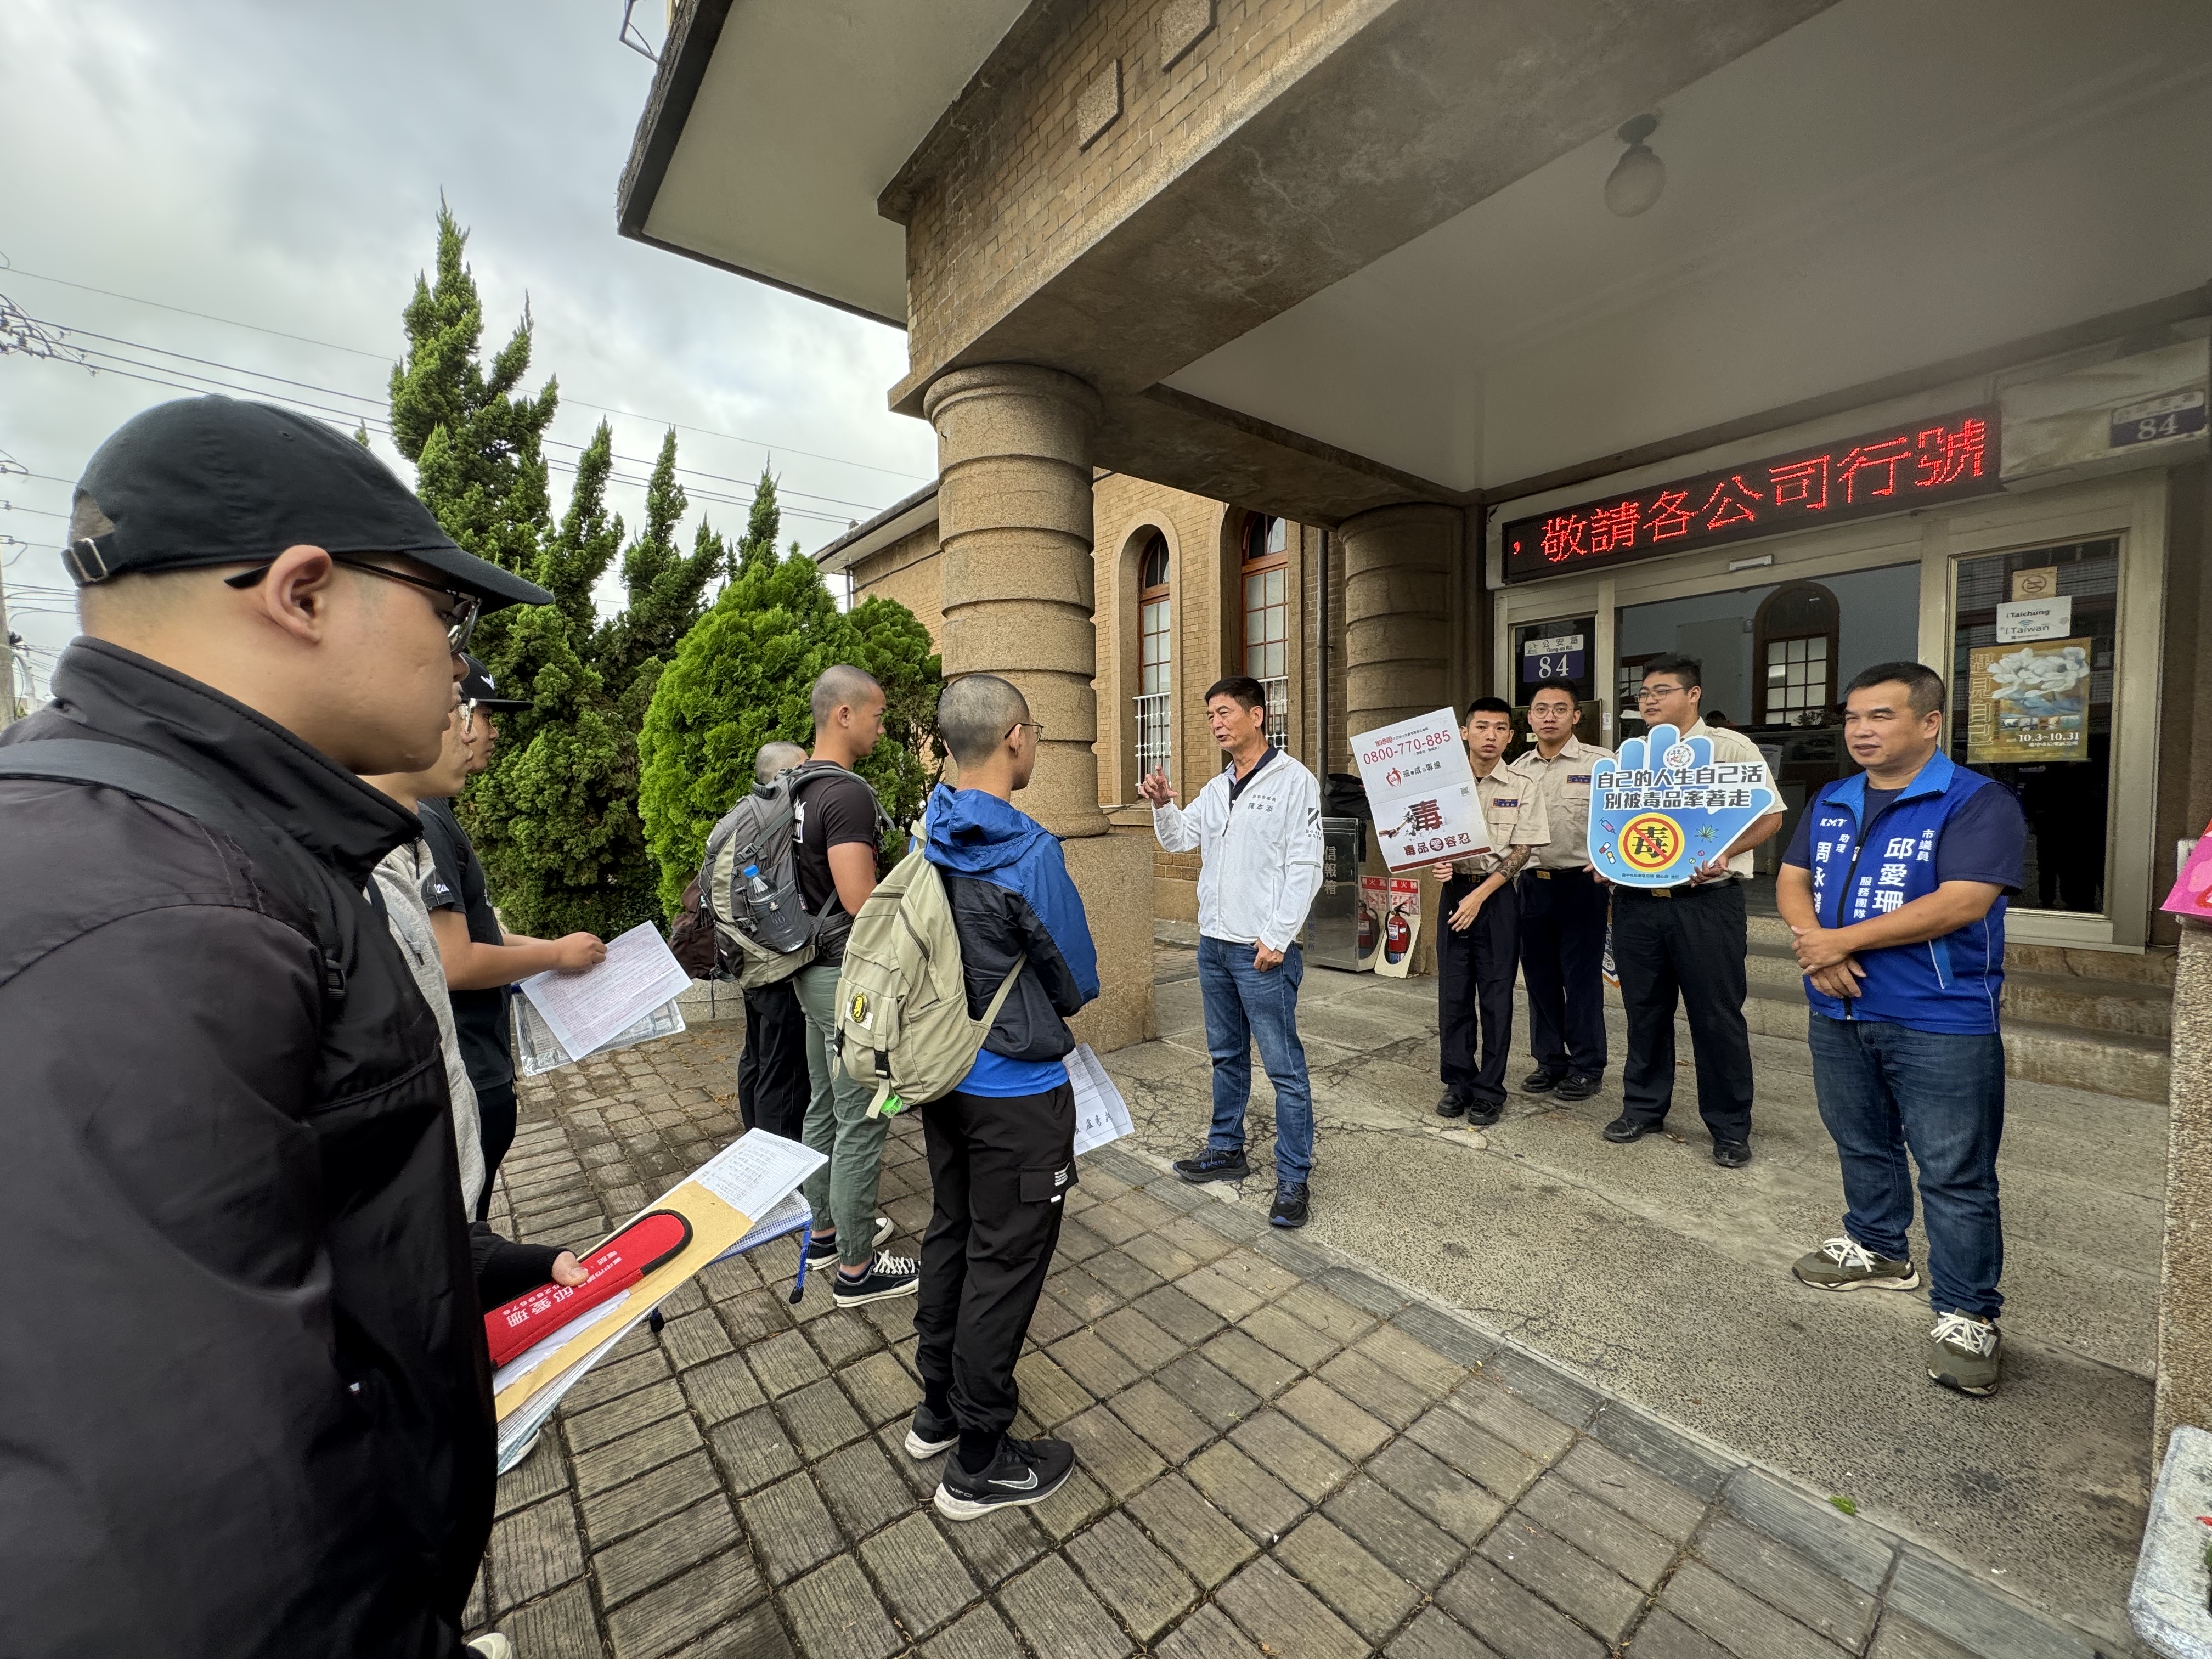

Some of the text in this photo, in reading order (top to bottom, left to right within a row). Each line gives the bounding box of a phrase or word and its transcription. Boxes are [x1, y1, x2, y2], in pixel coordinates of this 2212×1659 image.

[2138, 414, 2179, 439] 84
[1542, 636, 1578, 648] 公安路
[1539, 654, 1569, 678] 84
[1363, 730, 1451, 764] 0800-770-885
[2018, 732, 2080, 742] 10.3~10.31
[1598, 764, 1763, 788] 自己的人生自己活
[1605, 788, 1750, 809] 別被毒品牽著走
[1820, 818, 1848, 827] KMT
[1403, 832, 1471, 856] 毒品零容忍
[1631, 826, 1668, 859] 毒
[1835, 834, 1850, 853] 助理
[1916, 829, 1936, 862] 市議員
[1323, 845, 1336, 895] 信報箱
[1872, 837, 1916, 913] 邱愛珊
[1853, 876, 1873, 919] 服務團隊
[506, 1286, 574, 1328] 邱愛珊
